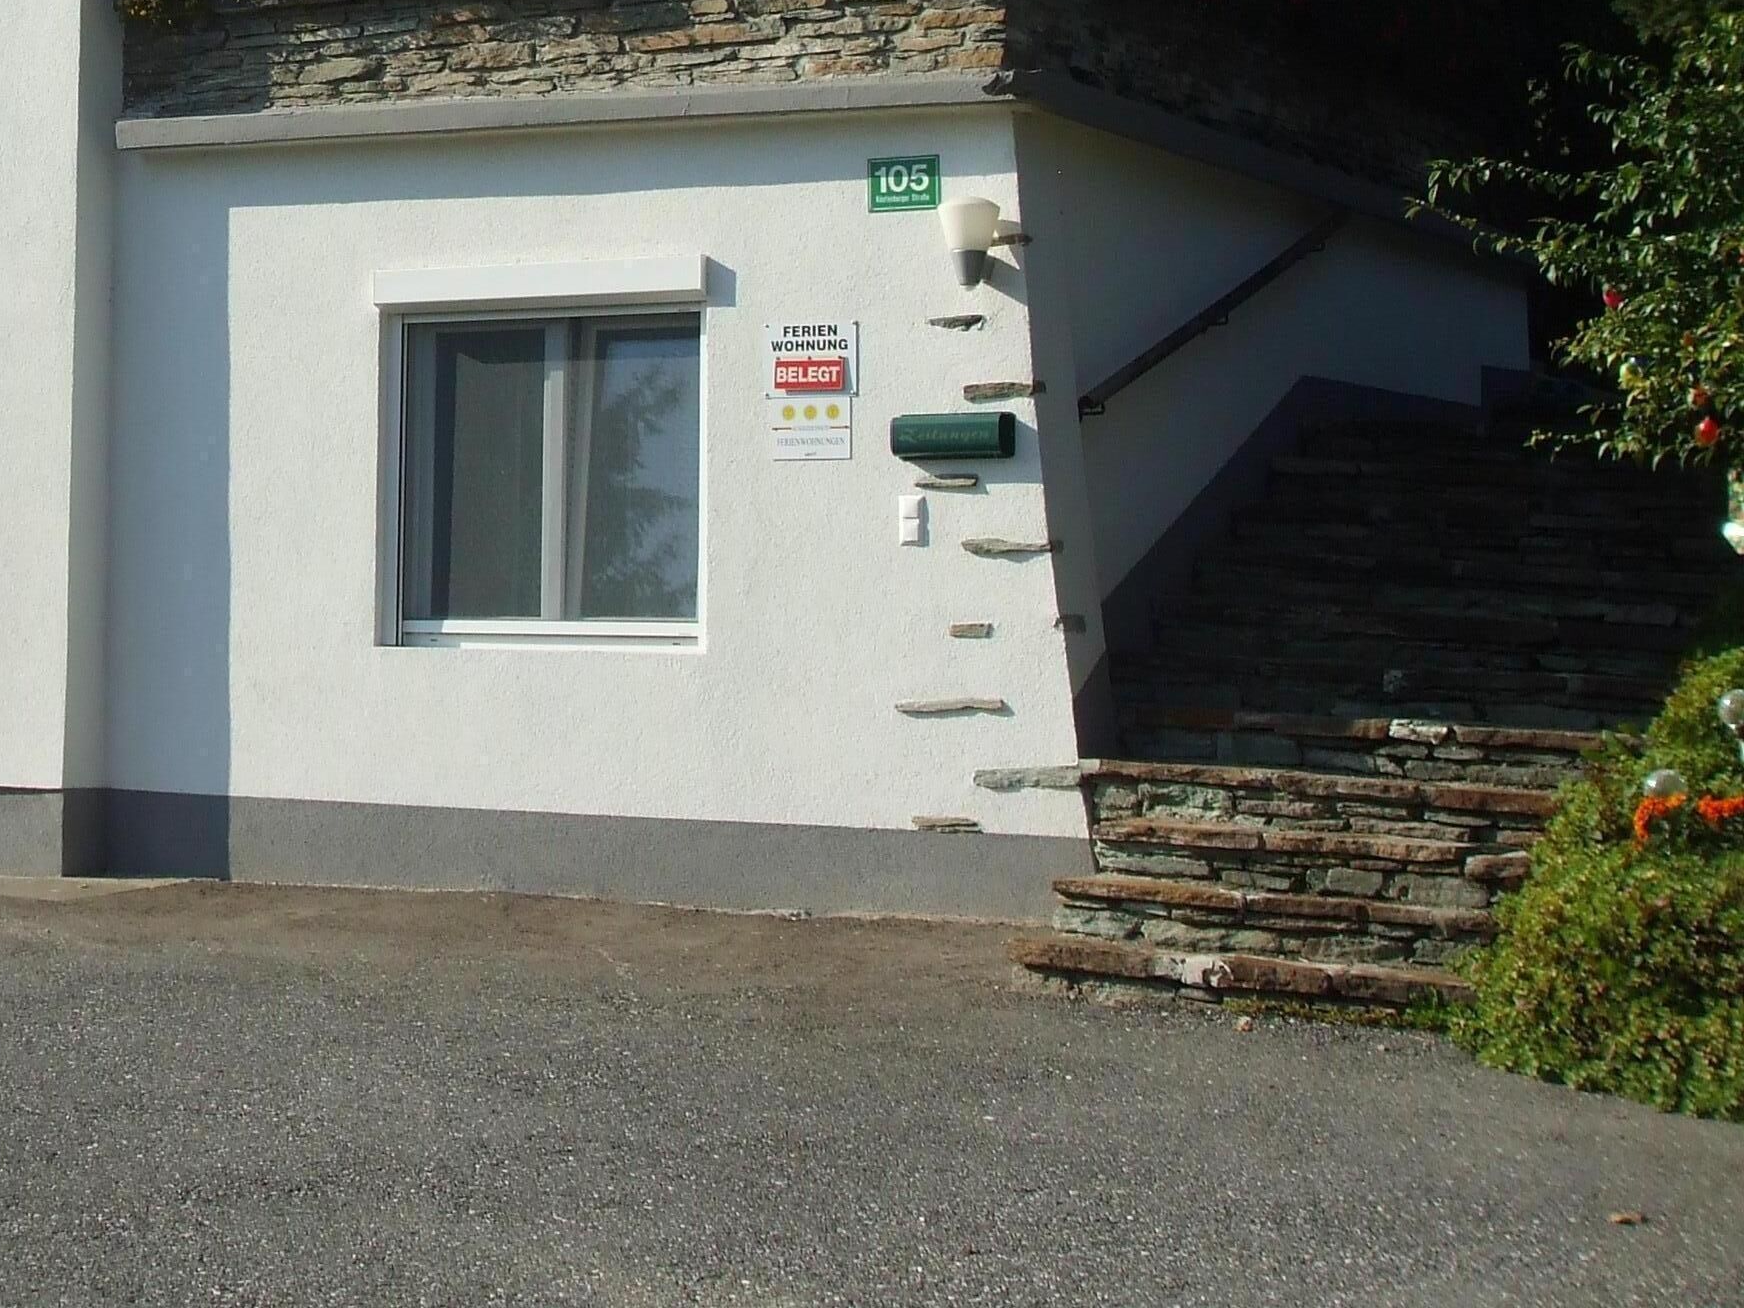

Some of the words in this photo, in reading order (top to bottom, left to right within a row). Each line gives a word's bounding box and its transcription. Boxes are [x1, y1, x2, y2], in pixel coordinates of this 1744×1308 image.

[873, 164, 930, 193] 105
[783, 324, 838, 338] FERIEN
[771, 338, 849, 352] WOHNUNG
[775, 365, 841, 383] BELEGT
